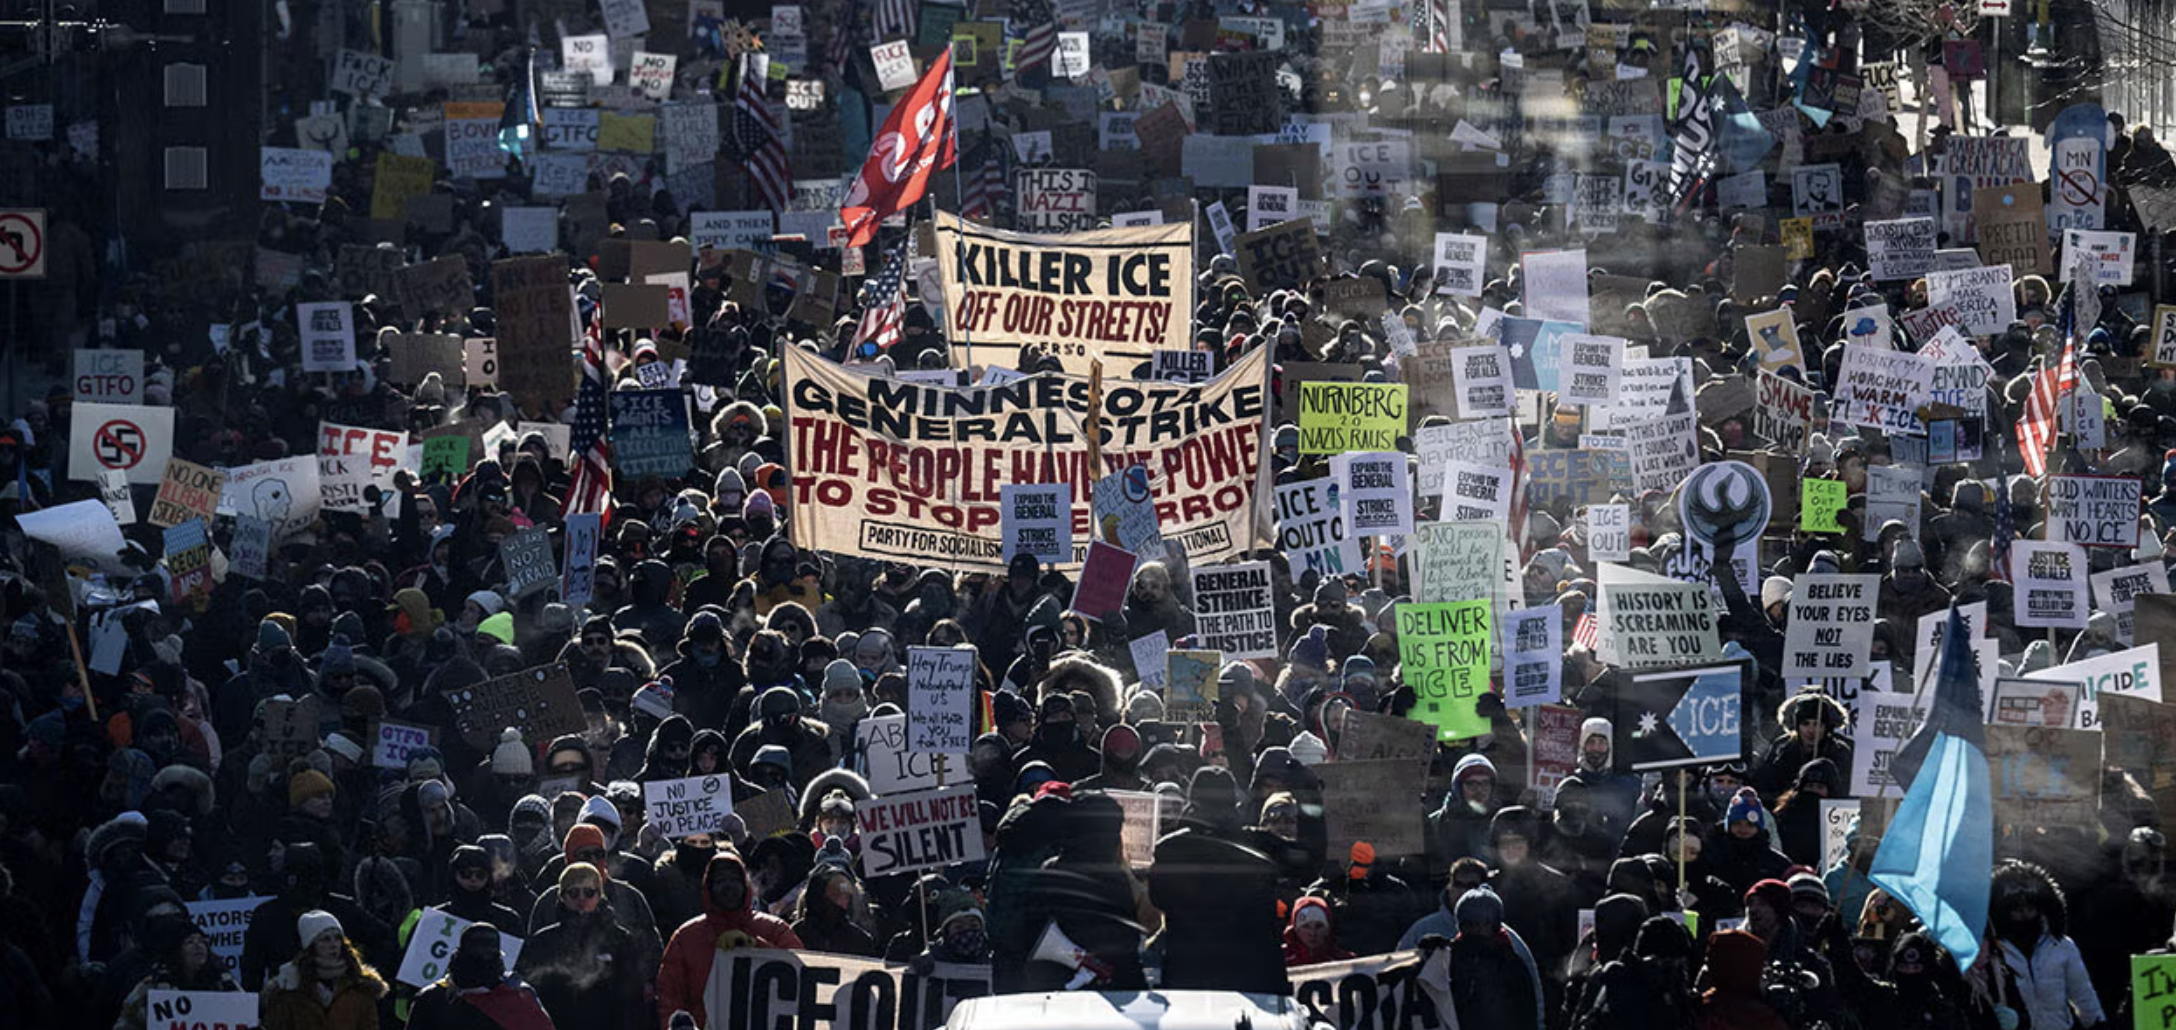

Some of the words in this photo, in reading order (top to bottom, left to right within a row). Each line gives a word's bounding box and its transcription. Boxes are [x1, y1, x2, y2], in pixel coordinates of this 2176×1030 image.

[573, 41, 594, 53] NO
[875, 45, 906, 64] FUCK
[644, 57, 666, 69] NO
[640, 79, 662, 91] NO
[786, 81, 823, 94] ICE
[1861, 69, 1897, 85] FUCK
[558, 109, 587, 121] ICE
[1347, 144, 1391, 163] ICE
[2066, 151, 2092, 167] MN
[1020, 171, 1074, 191] THIS
[1078, 170, 1097, 193] IS
[1344, 166, 1400, 192] OUT
[1023, 192, 1086, 212] NAZI
[736, 217, 770, 229] THEN
[1985, 222, 2037, 245] PRETTI
[695, 235, 729, 246] THEY
[1246, 229, 1311, 258] ICE
[955, 240, 1095, 294] KILLER
[1107, 254, 1171, 296] ICE
[1952, 289, 1984, 299] MAKE
[955, 291, 996, 333] OFF
[1002, 293, 1059, 336] OUR
[1060, 299, 1172, 344] STREETS!
[90, 353, 126, 375] ICE
[1160, 352, 1207, 371] KILLER
[1573, 354, 1610, 367] GENERAL
[77, 374, 136, 396] GTFO
[1847, 371, 1921, 393] HORCHATA
[630, 396, 663, 410] ICE
[867, 377, 1201, 416] MINNESOTA
[1758, 373, 1812, 420] SHAME
[1852, 385, 1908, 408] WARM
[617, 409, 672, 426] AGENTS
[793, 379, 1074, 445] GENERAL
[1083, 384, 1262, 446] STRIKE
[1885, 408, 1921, 430] ICE
[630, 425, 662, 439] ARE
[1421, 423, 1505, 445] SILENCE
[1656, 422, 1666, 436] IS
[1667, 417, 1691, 434] WHAT
[1756, 406, 1804, 449] TRUMP
[322, 426, 400, 468] ICE
[1301, 427, 1345, 451] NAZIS
[1633, 444, 1643, 457] IT
[1644, 437, 1679, 456] SOUNDS
[792, 416, 860, 477] THE
[864, 437, 1002, 502] PEOPLE
[1529, 453, 1591, 479] ICE
[1641, 458, 1661, 472] LIKE
[1663, 453, 1687, 468] WHEN
[167, 463, 190, 483] NO
[192, 471, 222, 493] ONE
[1351, 473, 1395, 489] GENERAL
[1809, 482, 1838, 494] ICE
[158, 483, 210, 512] ILLEGAL
[1456, 483, 1499, 502] GENERAL
[2049, 480, 2081, 499] COLD
[2083, 480, 2140, 499] WINTERS
[792, 477, 854, 508] TO
[865, 487, 1001, 534] STOP
[1014, 505, 1058, 519] GENERAL
[1280, 487, 1321, 519] ICE
[2086, 502, 2138, 521] HEARTS
[1593, 508, 1621, 526] ICE
[868, 526, 911, 552] PARTY
[912, 530, 935, 553] FOR
[1285, 521, 1322, 550] OUT
[1432, 527, 1455, 545] NO
[1592, 532, 1625, 552] OUT
[2064, 520, 2092, 542] NO
[2097, 521, 2128, 543] ICE
[186, 547, 207, 569] OUT
[510, 547, 542, 568] NOT
[1304, 546, 1345, 576] MN
[2029, 550, 2070, 567] JUSTICE
[1195, 570, 1269, 592] GENERAL
[1808, 583, 1862, 600] BELIEVE
[2111, 572, 2150, 592] JUSTICE
[1197, 592, 1270, 613] STRIKE:
[1615, 590, 1684, 611] HISTORY
[1692, 589, 1708, 610] IS
[1198, 615, 1224, 633] THE
[1225, 614, 1255, 632] PATH
[1257, 612, 1272, 628] TO
[1402, 606, 1488, 636] DELIVER
[1615, 612, 1711, 633] SCREAMING
[1795, 606, 1830, 622] YOUR
[1836, 605, 1871, 621] EYES
[1205, 631, 1275, 651] JUSTICE
[1627, 636, 1659, 655] ARE
[1669, 635, 1702, 655] YOU
[1814, 628, 1842, 643] NOT
[1405, 646, 1432, 669] US
[1435, 639, 1487, 667] FROM
[1795, 654, 1822, 668] THE
[1825, 653, 1854, 668] LIES
[911, 655, 936, 677] Hey
[937, 654, 971, 676] Trump
[1414, 667, 1474, 699] ICE
[930, 692, 948, 705] US
[1685, 693, 1741, 738] ICE
[380, 726, 425, 746] GTFO
[896, 752, 952, 781] ICE
[666, 782, 686, 800] NO
[652, 797, 715, 819] JUSTICE
[857, 805, 892, 832] WE
[893, 801, 928, 826] WILL
[930, 797, 957, 821] NOT
[959, 793, 978, 818] BE
[677, 812, 723, 833] PEACE
[870, 822, 967, 872] SILENT
[729, 955, 841, 1030] ICE
[154, 996, 192, 1018] NO
